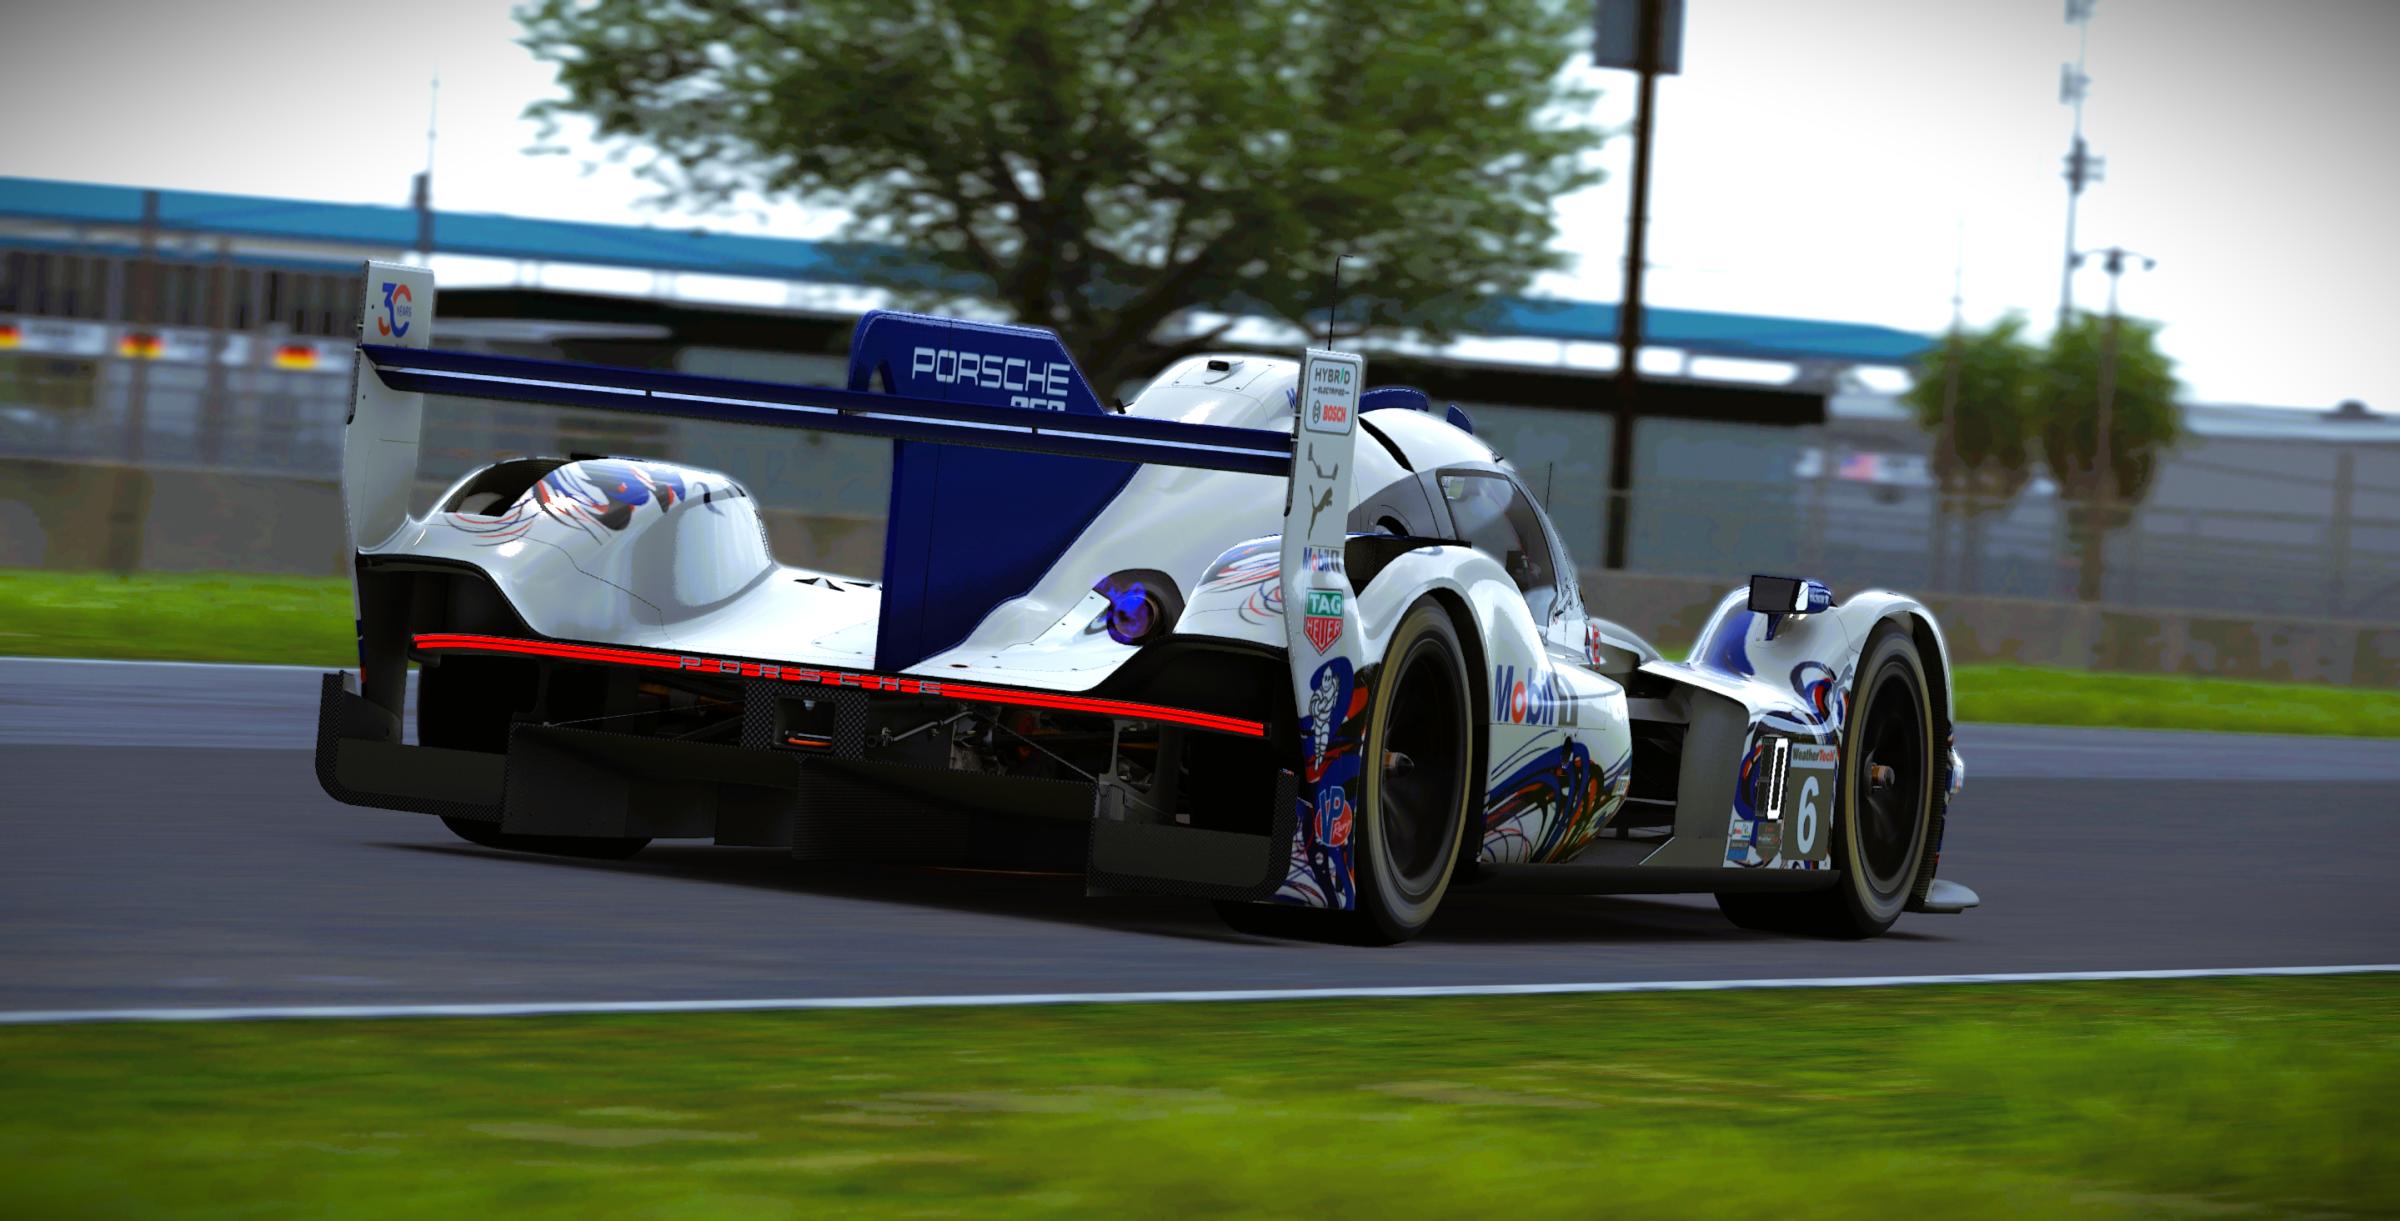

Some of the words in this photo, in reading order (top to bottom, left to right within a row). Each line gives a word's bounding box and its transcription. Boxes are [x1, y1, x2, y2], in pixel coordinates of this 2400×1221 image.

[911, 346, 1072, 396] PORSCHE
[1322, 404, 1347, 424] BOSCH
[1302, 546, 1331, 573] Mobil
[1309, 593, 1343, 615] TAG
[1306, 618, 1342, 648] HEUER
[679, 655, 941, 695] PORSCHE
[1495, 664, 1554, 726] Mobil
[1792, 747, 1834, 762] WeatherTech
[1318, 785, 1346, 847] VP
[1797, 775, 1820, 855] 6
